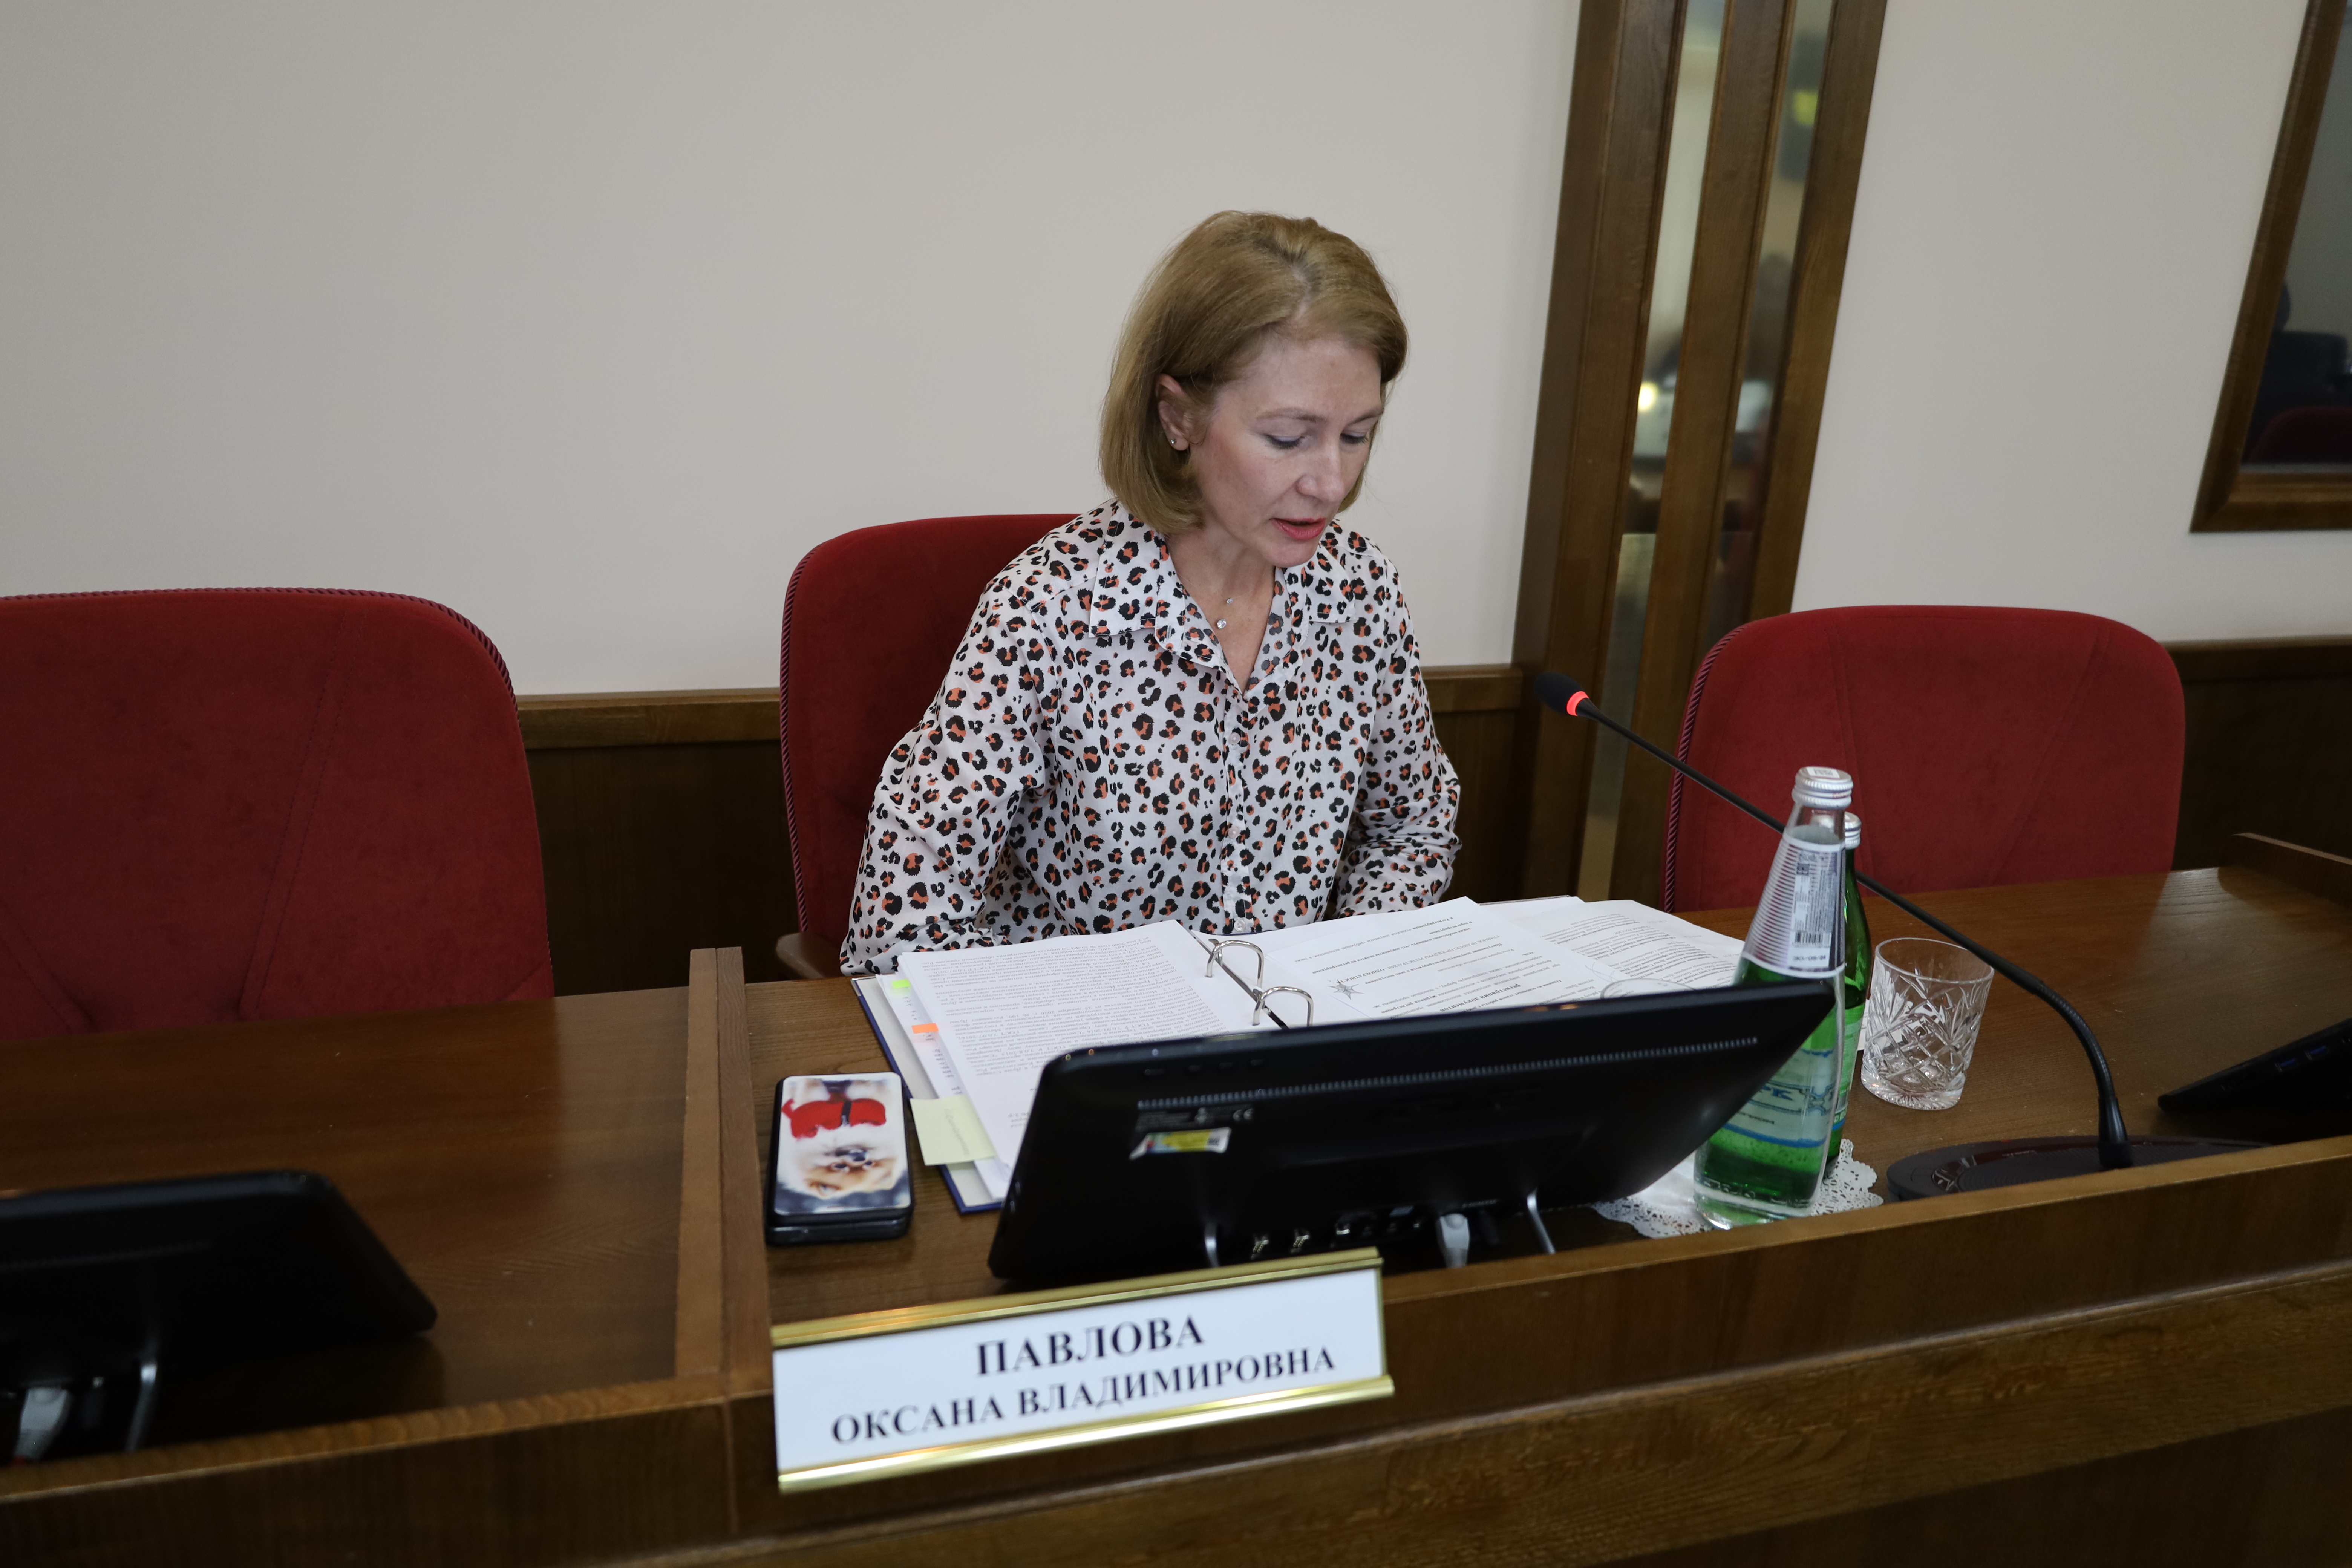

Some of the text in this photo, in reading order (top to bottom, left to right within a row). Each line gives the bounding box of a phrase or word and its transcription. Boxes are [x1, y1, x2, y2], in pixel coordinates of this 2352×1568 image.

[978, 1315, 1205, 1376] ПАВЛОВА
[832, 1347, 1335, 1443] ОКСАНА ВЛАДИМИРОВНА
